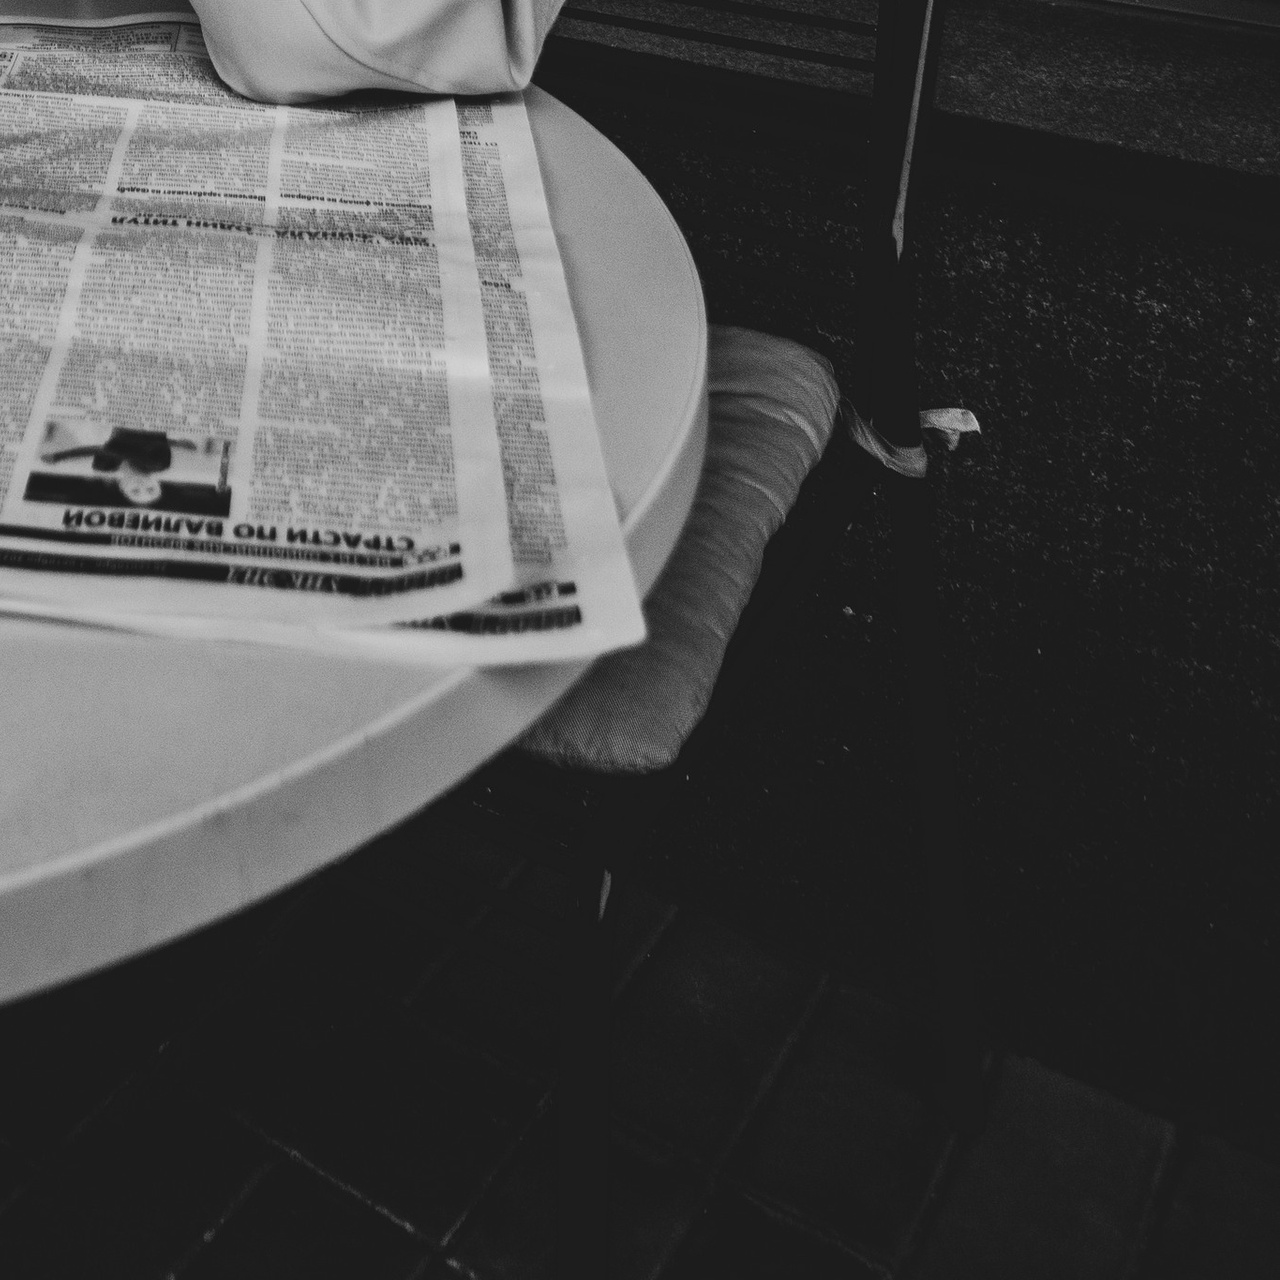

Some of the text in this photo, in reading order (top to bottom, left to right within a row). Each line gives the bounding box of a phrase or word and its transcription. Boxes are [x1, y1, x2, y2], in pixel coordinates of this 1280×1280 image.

[61, 508, 415, 553] СТРАСТИ ПО ВАЛИЕВОЙ
